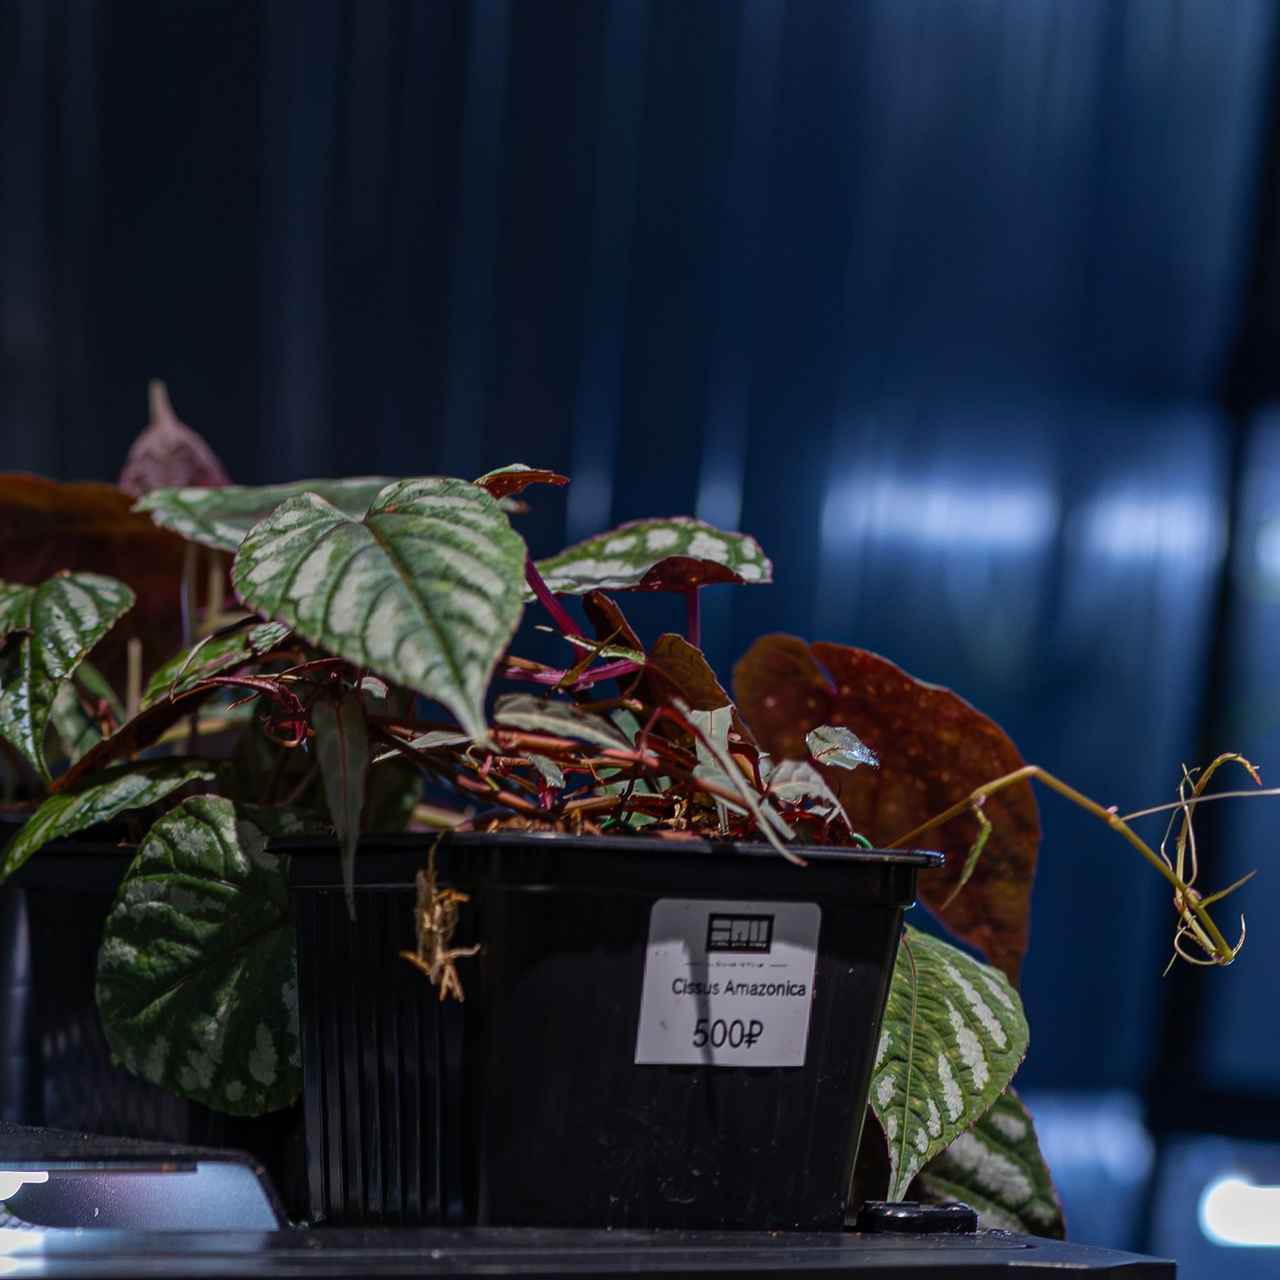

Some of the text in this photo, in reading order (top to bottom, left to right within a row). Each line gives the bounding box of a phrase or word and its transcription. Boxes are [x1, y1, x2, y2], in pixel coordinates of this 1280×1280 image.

[672, 978, 807, 998] Cissus Amazonica
[692, 1018, 764, 1049] 500₽
